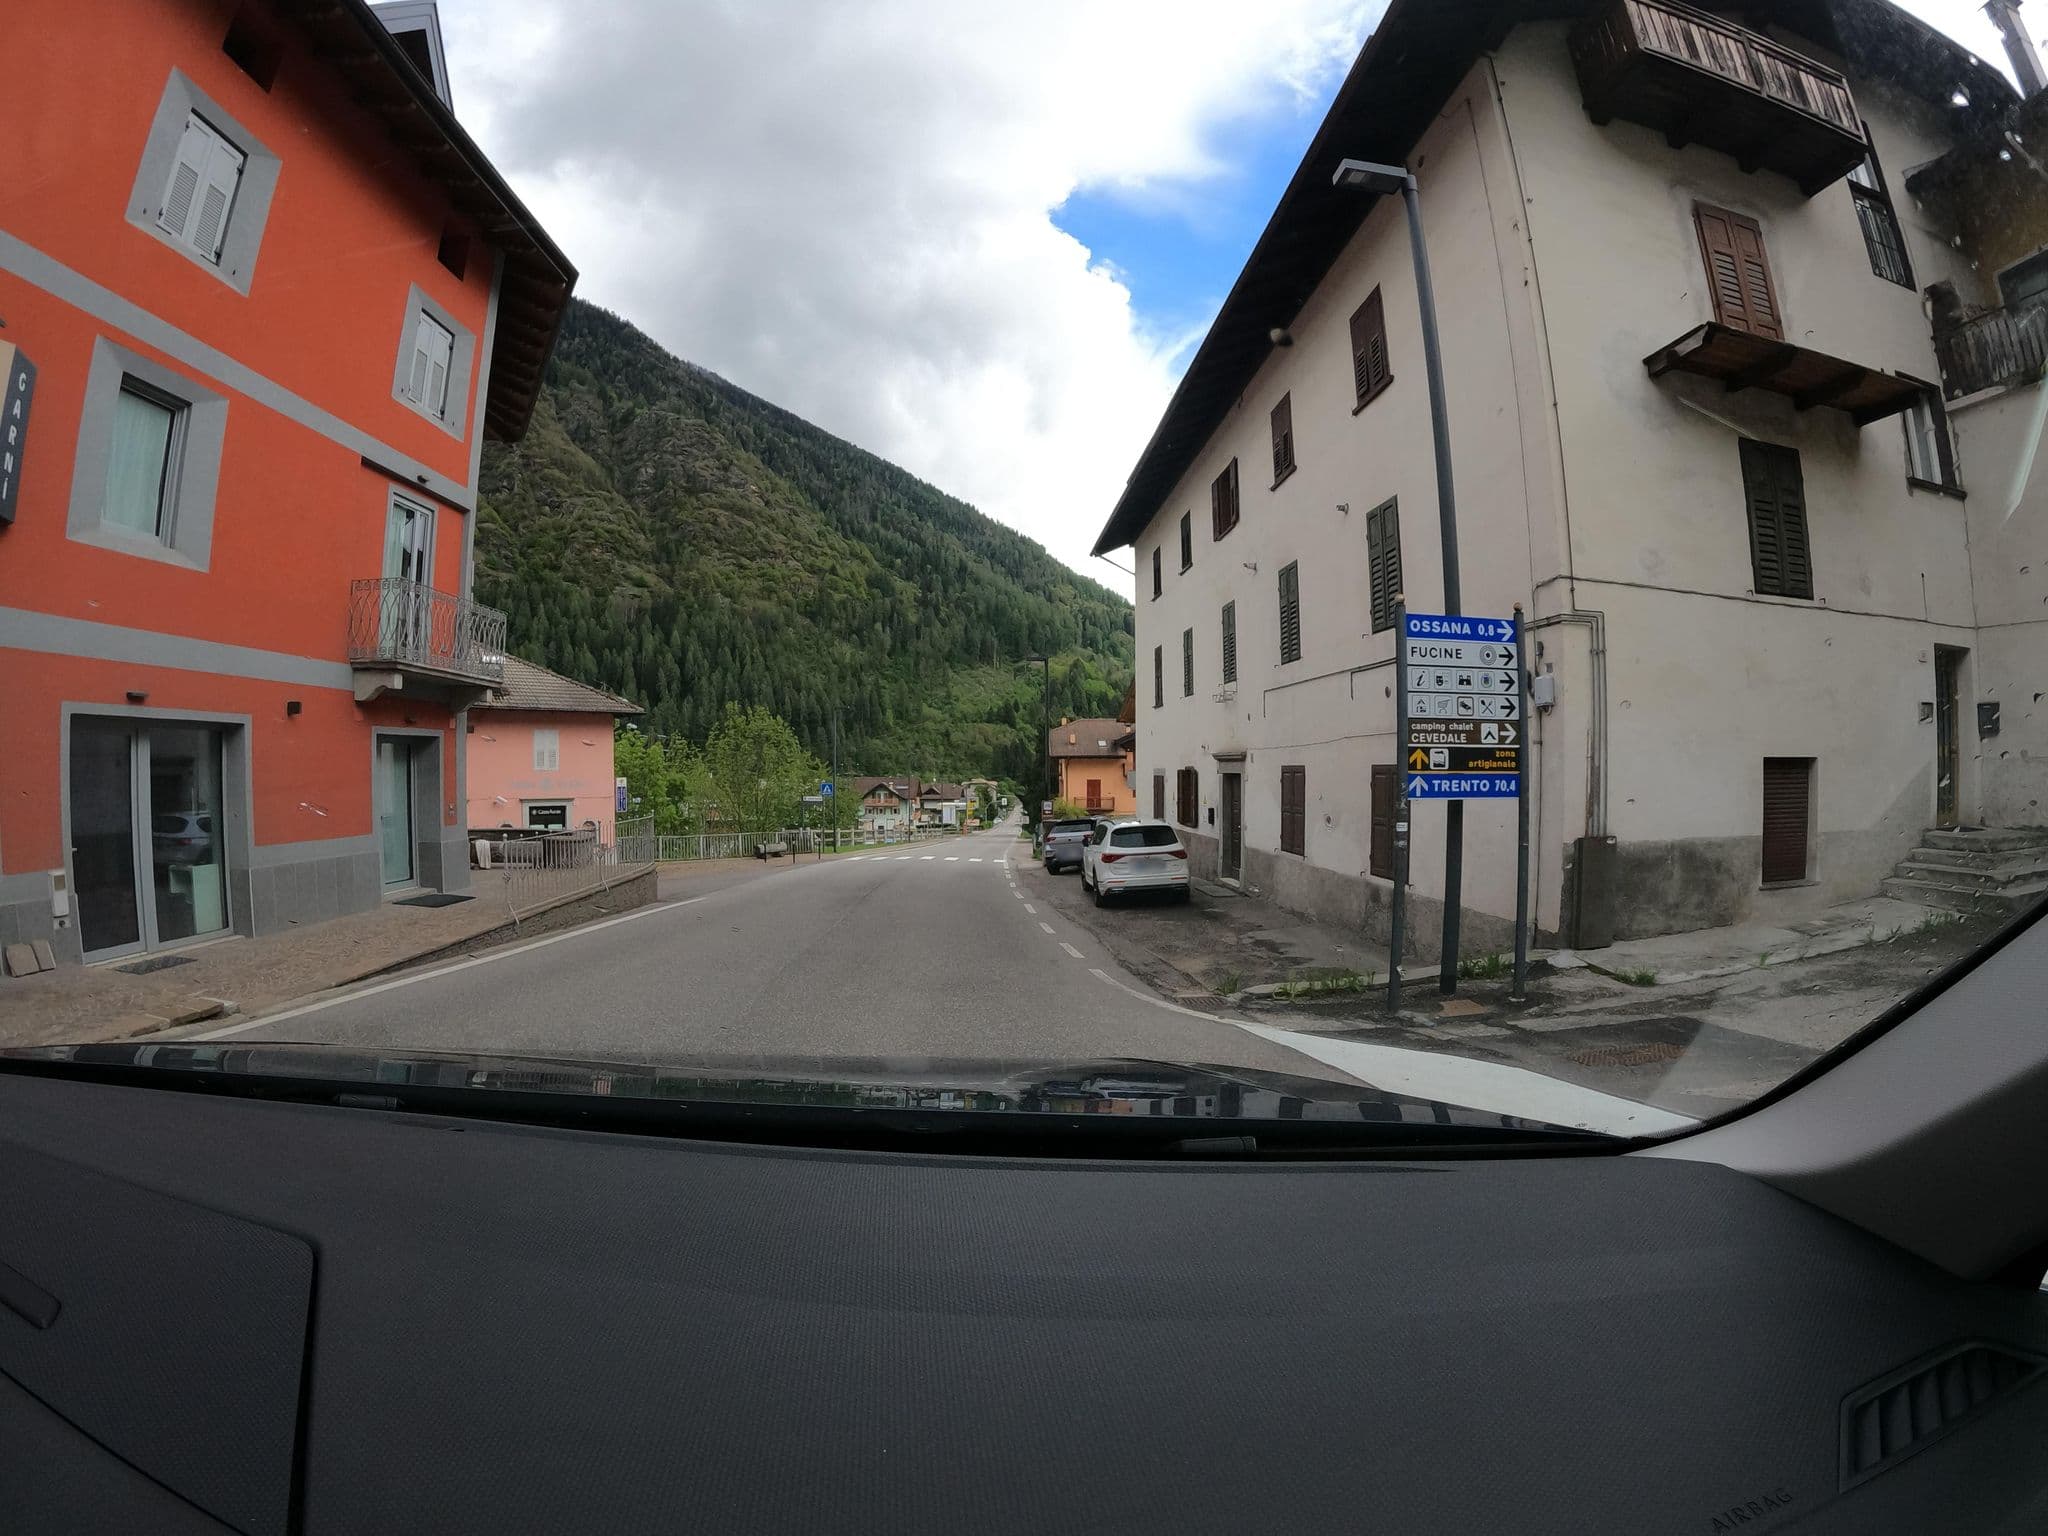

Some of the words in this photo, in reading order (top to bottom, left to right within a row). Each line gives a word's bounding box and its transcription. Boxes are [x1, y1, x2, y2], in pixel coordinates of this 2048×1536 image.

[1410, 619, 1471, 635] OSSANA
[1411, 646, 1463, 660] FUCINE
[1411, 722, 1446, 732] camping
[1448, 722, 1474, 731] chalet
[1411, 733, 1467, 744] CEVEDALE
[1495, 750, 1516, 758] zona
[1468, 760, 1516, 769] artigianale
[1432, 780, 1490, 792] TRENTO
[1494, 780, 1516, 793] 70,4
[1711, 1487, 1793, 1533] AIRBAG
